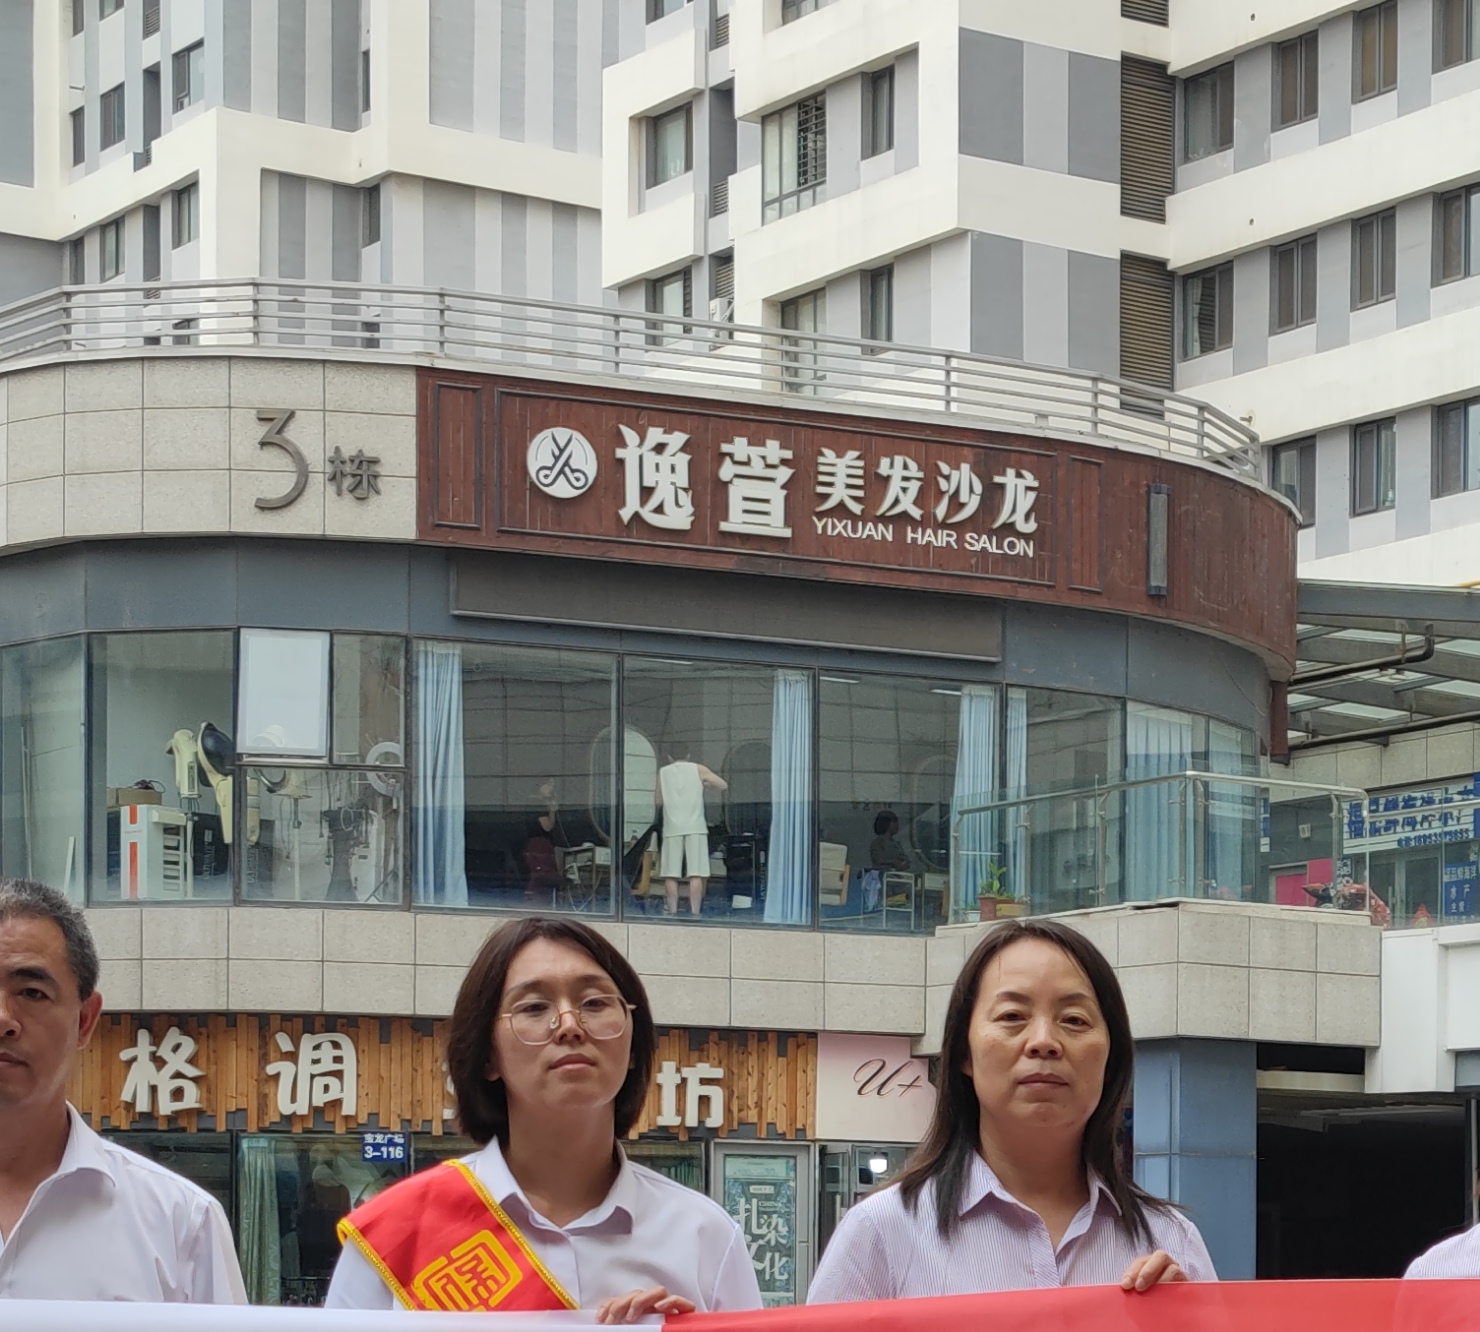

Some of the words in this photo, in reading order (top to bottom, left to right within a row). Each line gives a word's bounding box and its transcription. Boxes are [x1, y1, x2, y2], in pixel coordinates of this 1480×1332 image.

[615, 424, 795, 539] 逸萱
[816, 447, 1040, 535] 美发沙龙
[812, 515, 893, 543] YIXUAN
[907, 525, 957, 550] HAIR
[964, 531, 1035, 559] SALON
[363, 1144, 405, 1161] 3-116
